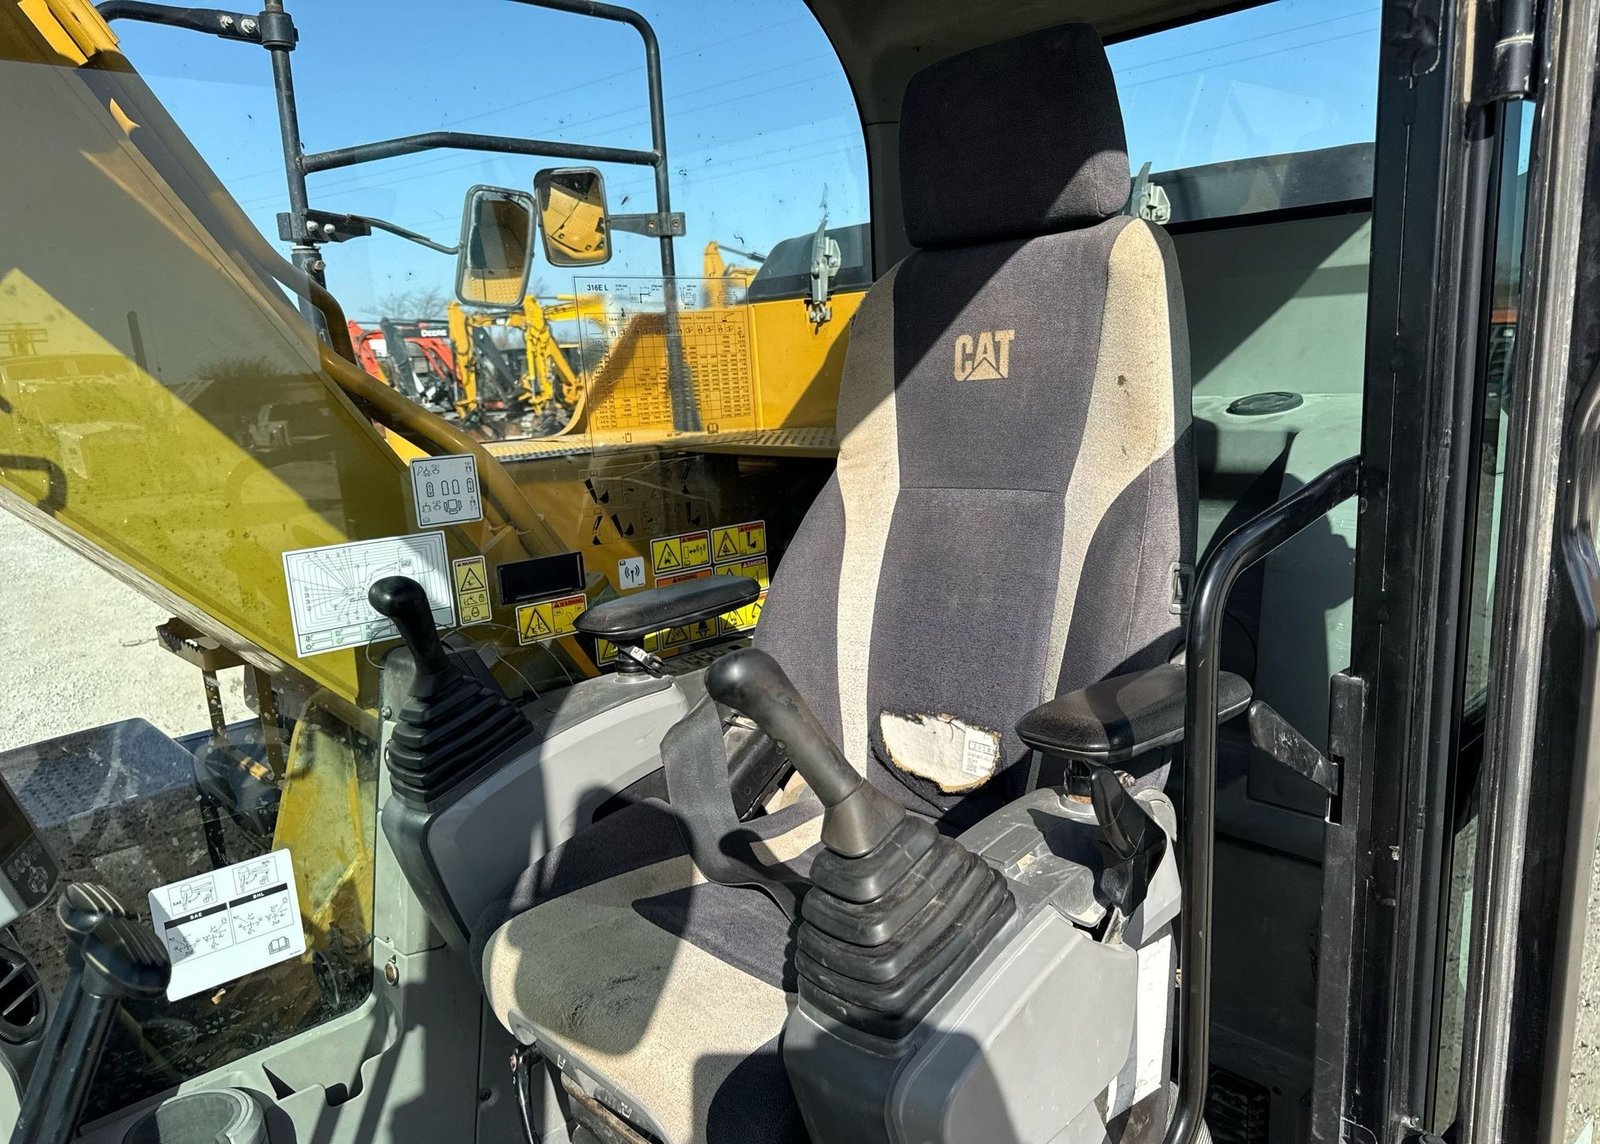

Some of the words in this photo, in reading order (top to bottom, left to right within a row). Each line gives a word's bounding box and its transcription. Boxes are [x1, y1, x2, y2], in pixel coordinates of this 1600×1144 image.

[421, 329, 448, 337] DEERE
[954, 329, 1015, 381] CAT
[190, 912, 202, 920] SAE
